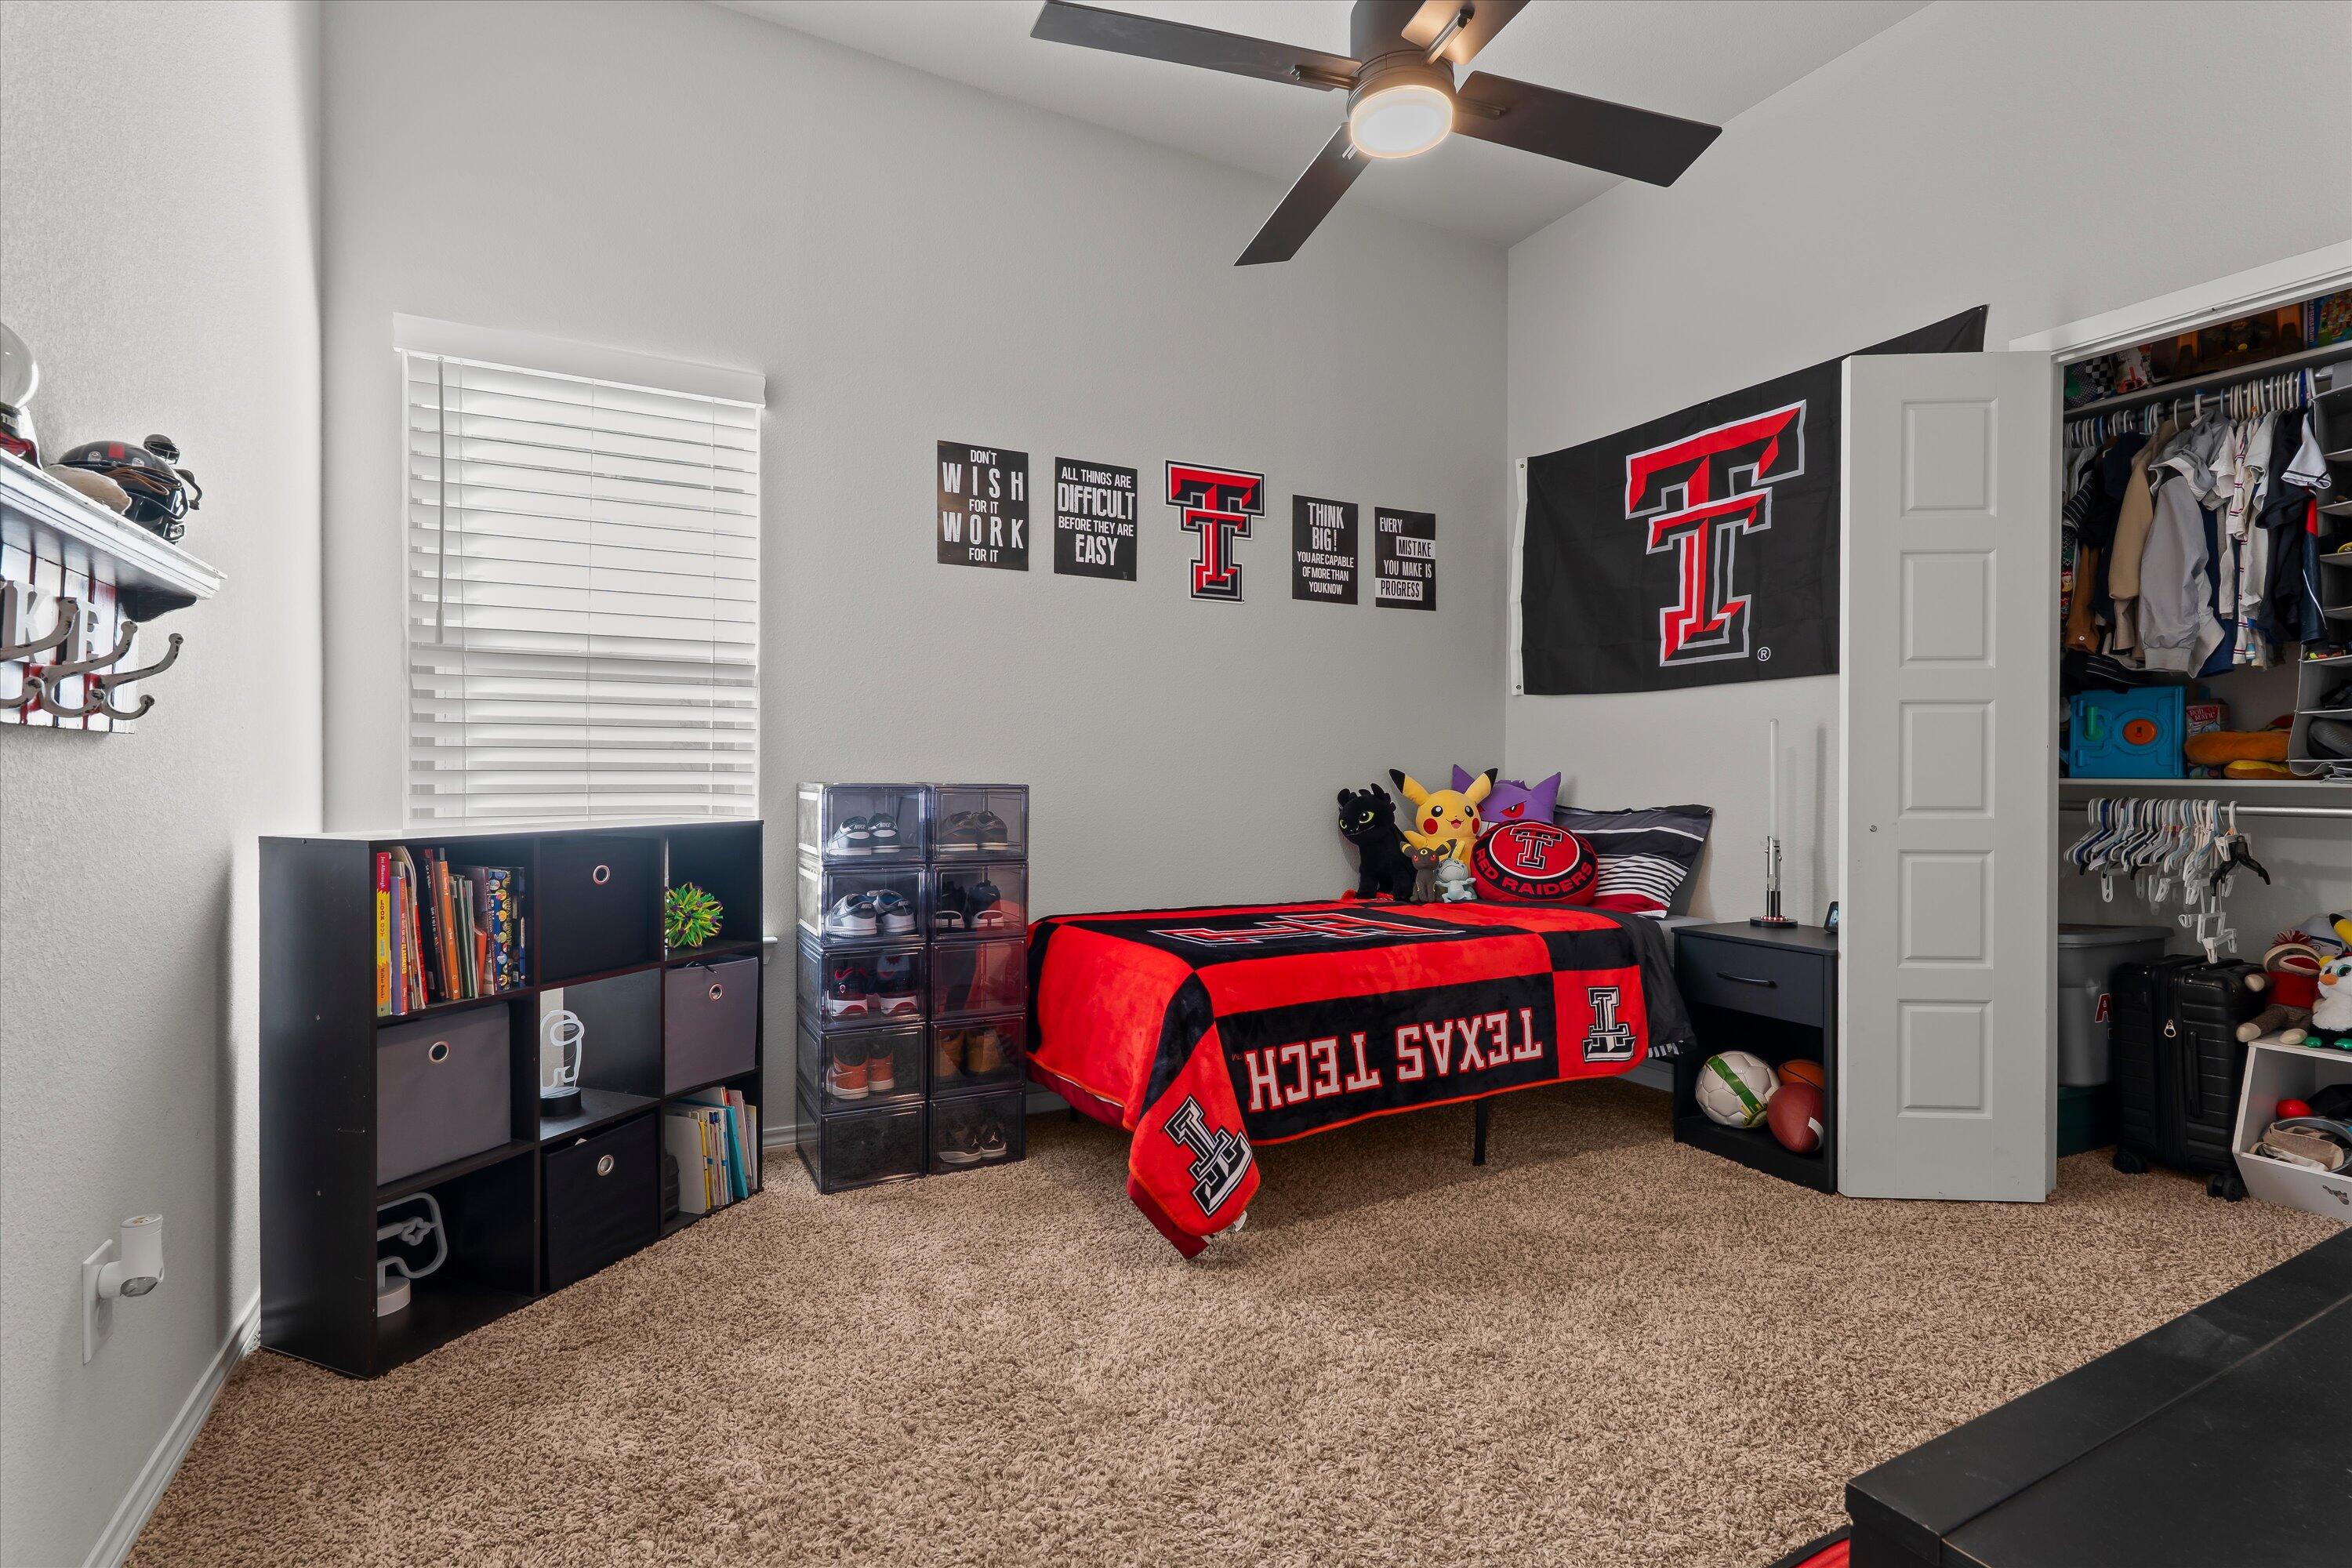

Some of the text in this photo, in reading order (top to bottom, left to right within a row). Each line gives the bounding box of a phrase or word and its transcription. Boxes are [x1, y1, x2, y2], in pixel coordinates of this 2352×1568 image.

[970, 449, 996, 463] DON'T
[942, 461, 1023, 502] WISH
[1062, 466, 1132, 488] ALL THINGS ARE
[968, 499, 999, 514] FOR IT
[1057, 482, 1135, 521] DIFFICULT
[1058, 516, 1134, 537] BEFORE THEY ARE
[1307, 503, 1345, 529] THINK
[1380, 517, 1403, 534] EVERY
[942, 511, 1024, 549] WORK
[1312, 526, 1338, 551] BIG!
[968, 547, 999, 563] FOR IT
[1075, 533, 1119, 566] EASY
[1398, 539, 1432, 557] MISTAKE
[1297, 551, 1354, 568] YOU ARE CAPABLE
[1384, 560, 1432, 578] YOU MAKE IS
[1302, 566, 1348, 582] OF MORE THAN
[1308, 581, 1342, 594] YOU KNOW
[1381, 579, 1420, 597] PROGRESS
[1475, 848, 1592, 895] RED RAIDERS
[1396, 1007, 1543, 1082] TEXAS
[1244, 1032, 1382, 1113] TECH
